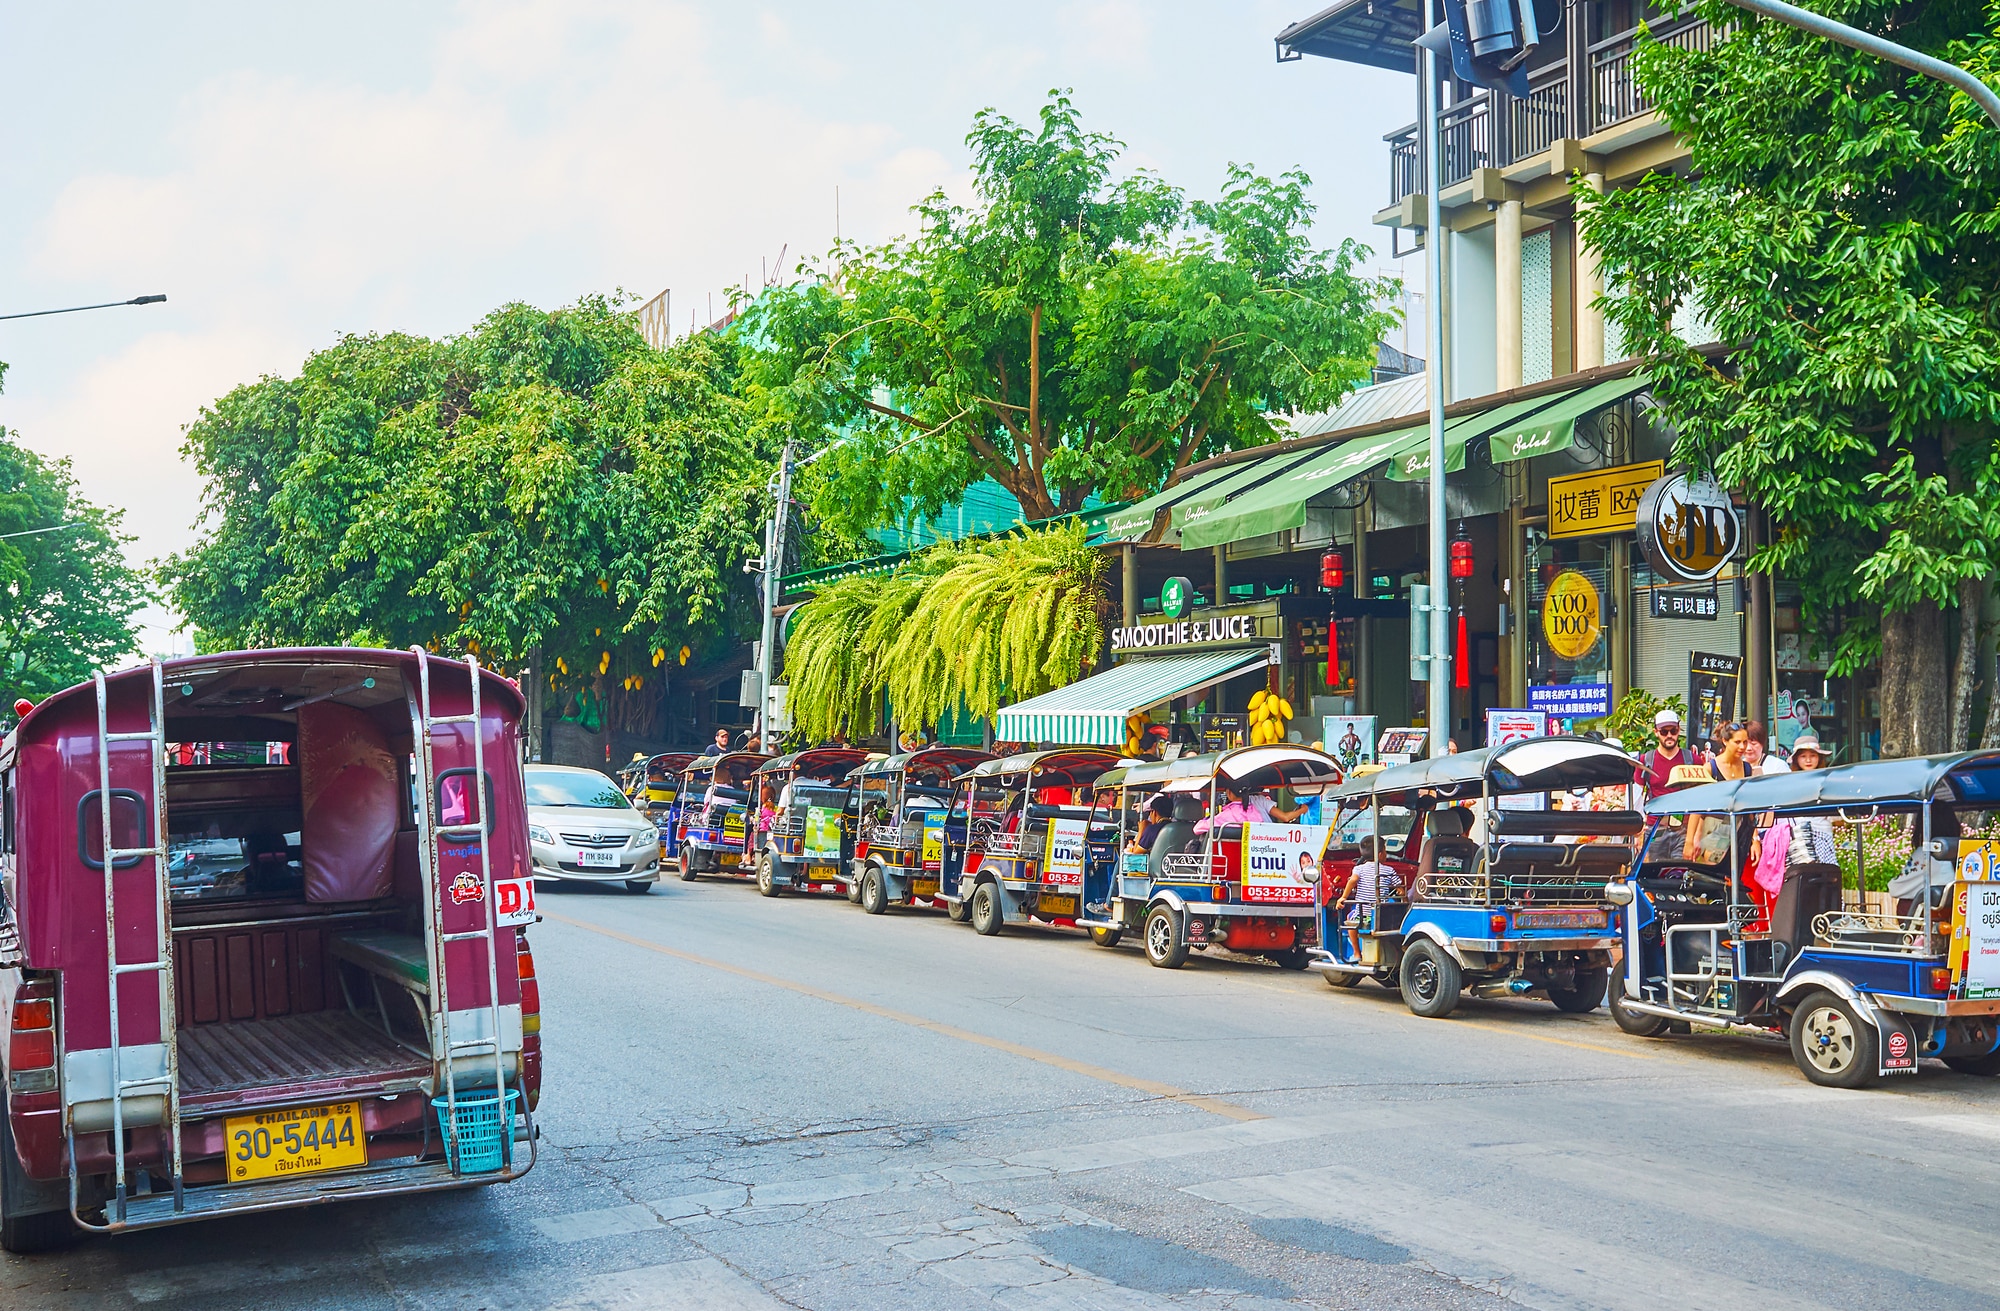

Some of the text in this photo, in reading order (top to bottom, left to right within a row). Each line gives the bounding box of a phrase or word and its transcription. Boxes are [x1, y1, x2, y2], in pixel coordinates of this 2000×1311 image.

[1512, 431, 1551, 455] Salad
[1554, 488, 1601, 524] 妆蕾
[1613, 487, 1645, 512] RA
[1184, 506, 1210, 521] Coffee
[1674, 503, 1736, 560] JD
[1550, 593, 1587, 614] VOO
[1111, 615, 1250, 650] SMOOTHIE & JUICE
[1552, 614, 1589, 635] DOO
[1701, 656, 1734, 670] 皇家蛇油
[1532, 689, 1578, 700] 泰国有名的产品
[1680, 767, 1706, 778] TAXI
[1288, 829, 1302, 843] 10
[1048, 873, 1081, 883] 053-2
[255, 1105, 351, 1124] THAILAND 52
[235, 1116, 355, 1161] 30-5444
[274, 1154, 321, 1171] เชียงใหม่
